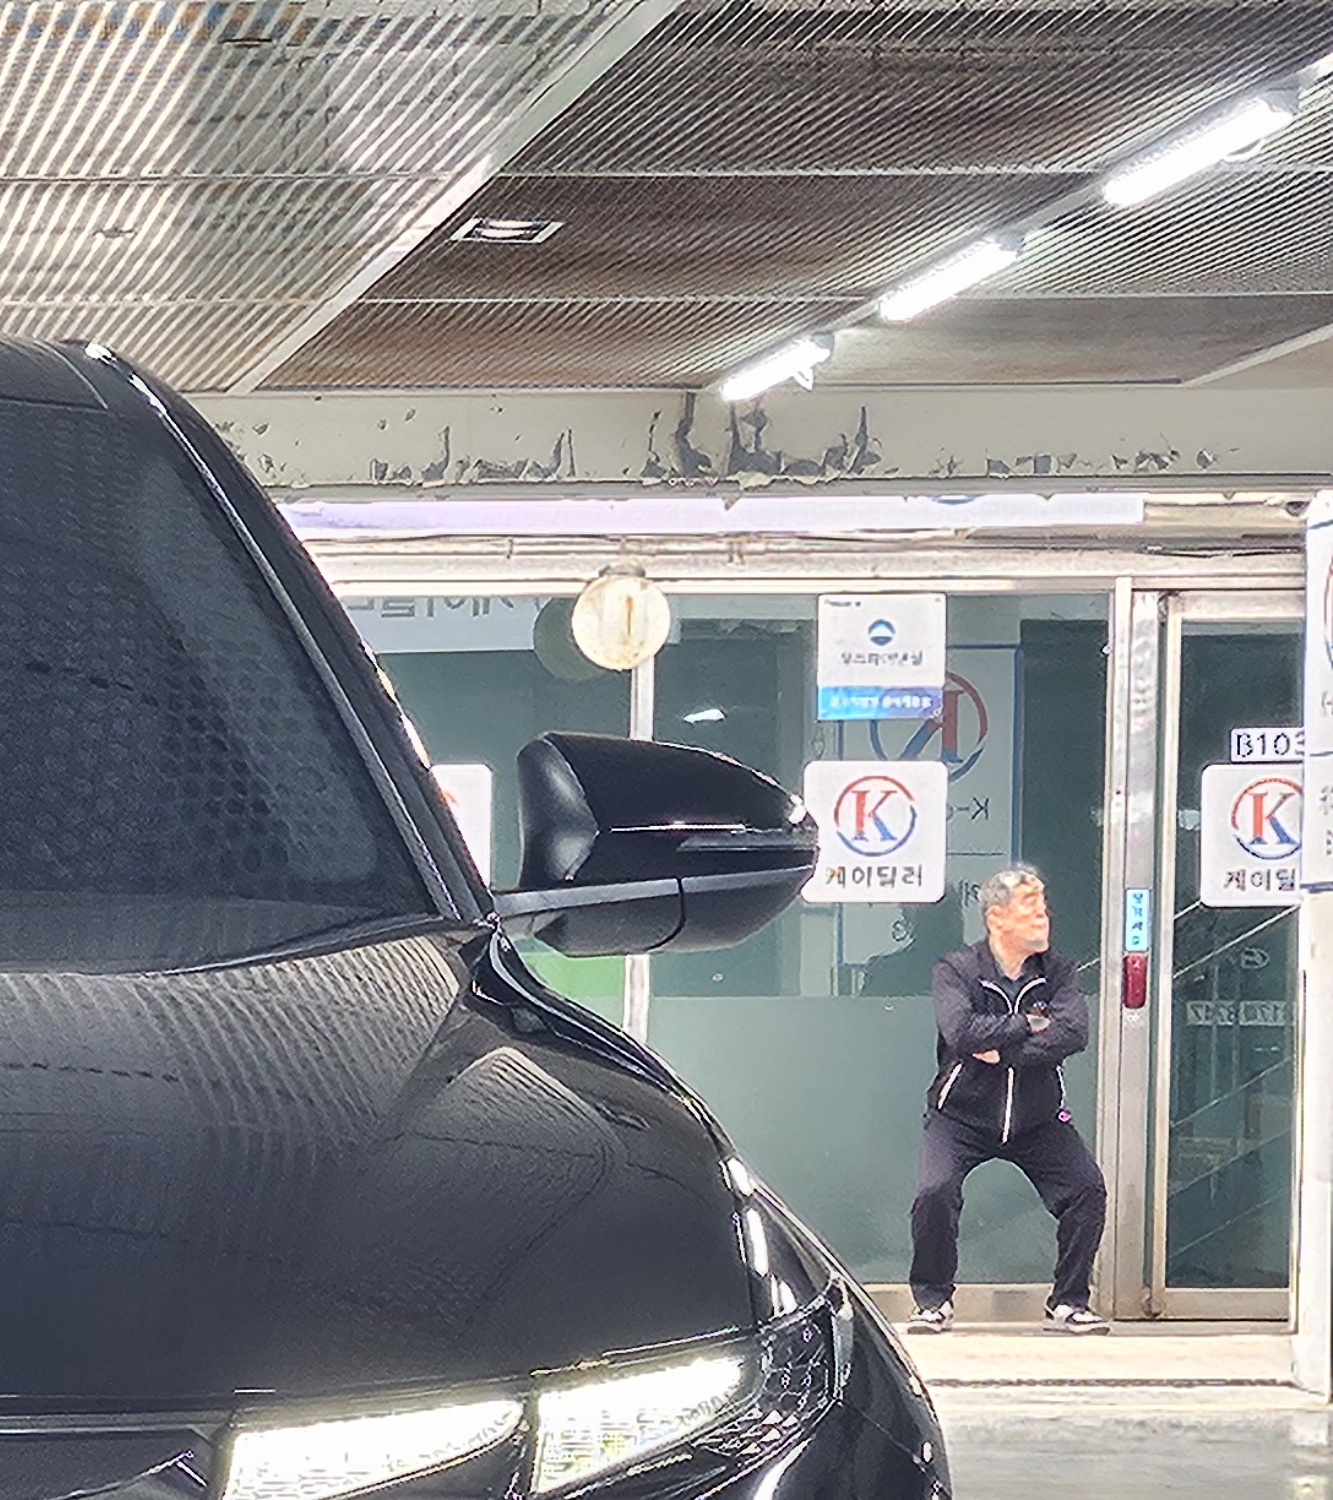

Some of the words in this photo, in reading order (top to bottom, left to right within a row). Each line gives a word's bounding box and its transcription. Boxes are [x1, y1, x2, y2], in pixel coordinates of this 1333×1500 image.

[851, 790, 898, 843] K
[1249, 791, 1297, 846] K
[824, 863, 923, 889] 케이딜러
[1223, 867, 1297, 891] 케이딜
